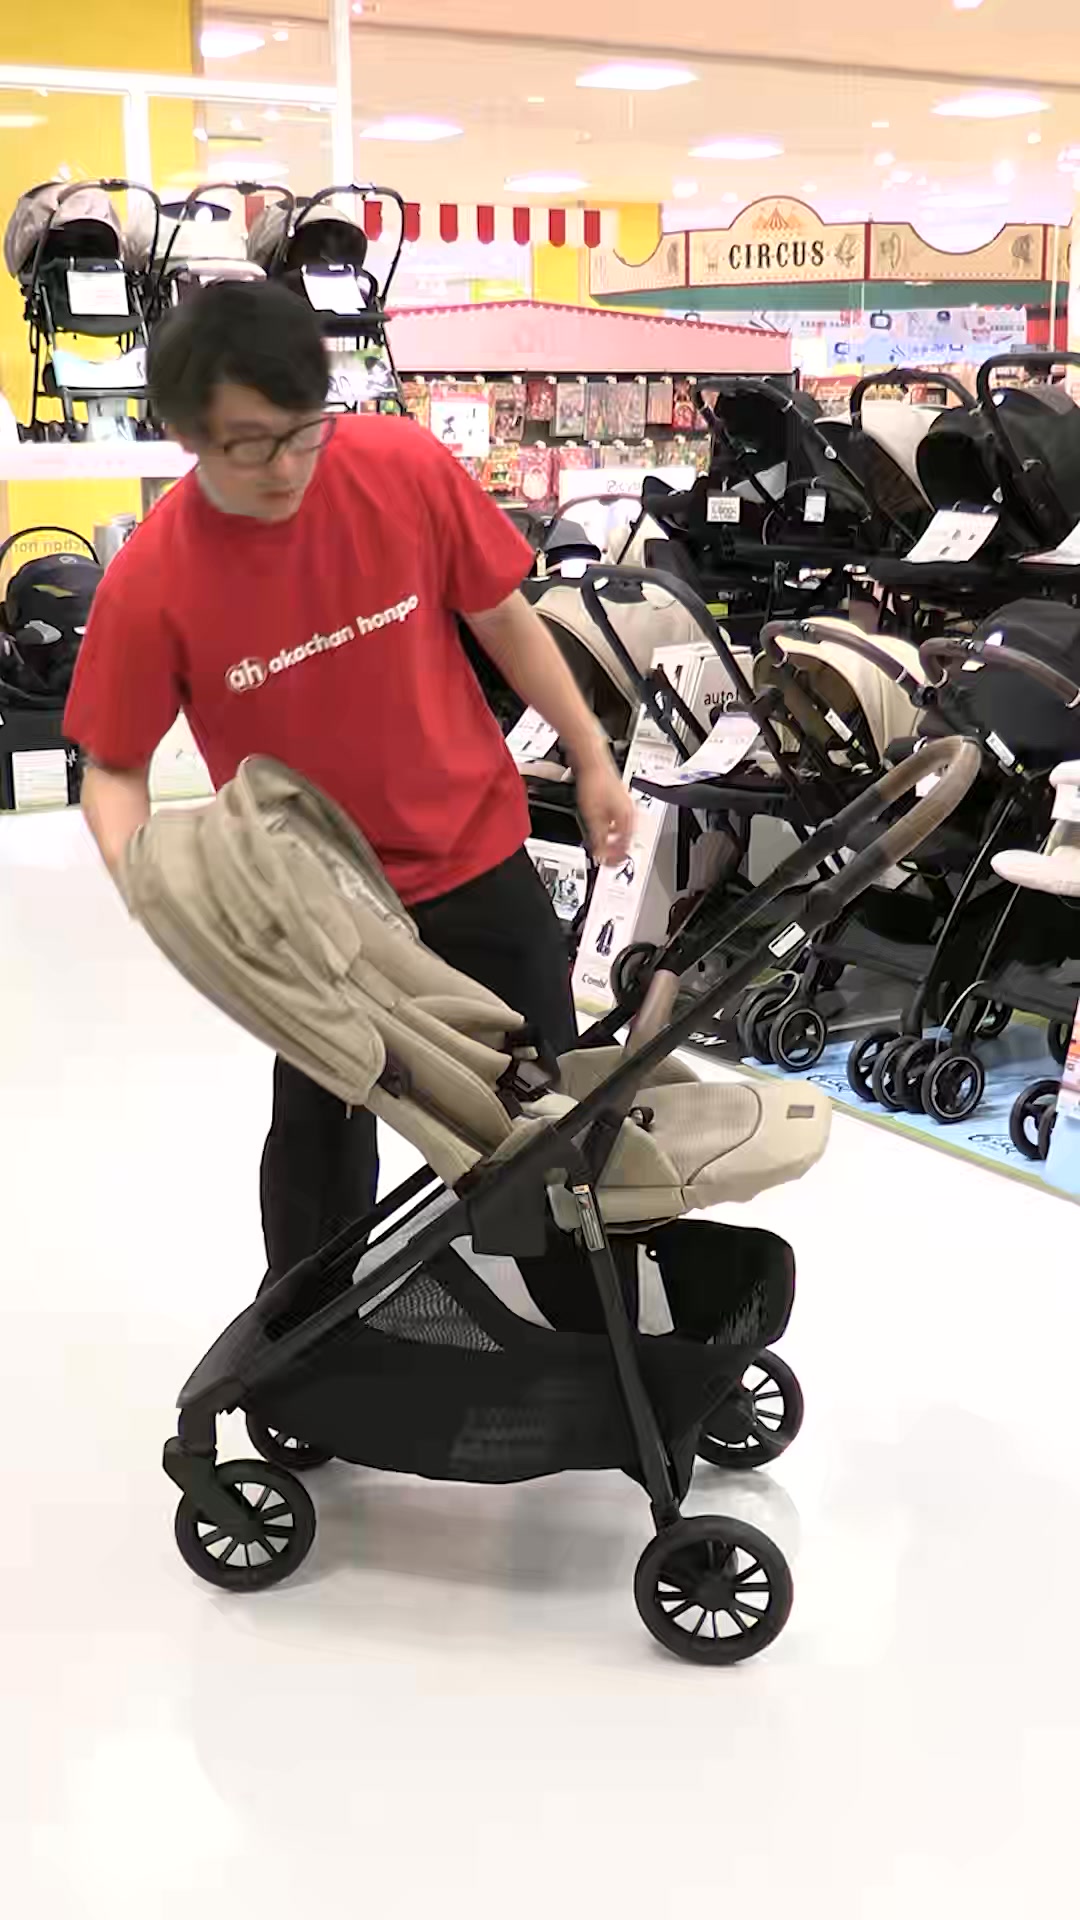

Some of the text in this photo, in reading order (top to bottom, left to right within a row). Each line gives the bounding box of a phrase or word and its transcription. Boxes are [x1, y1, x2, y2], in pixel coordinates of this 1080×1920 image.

[728, 240, 824, 270] CIRCUS
[227, 594, 419, 690] ah akachan honpo
